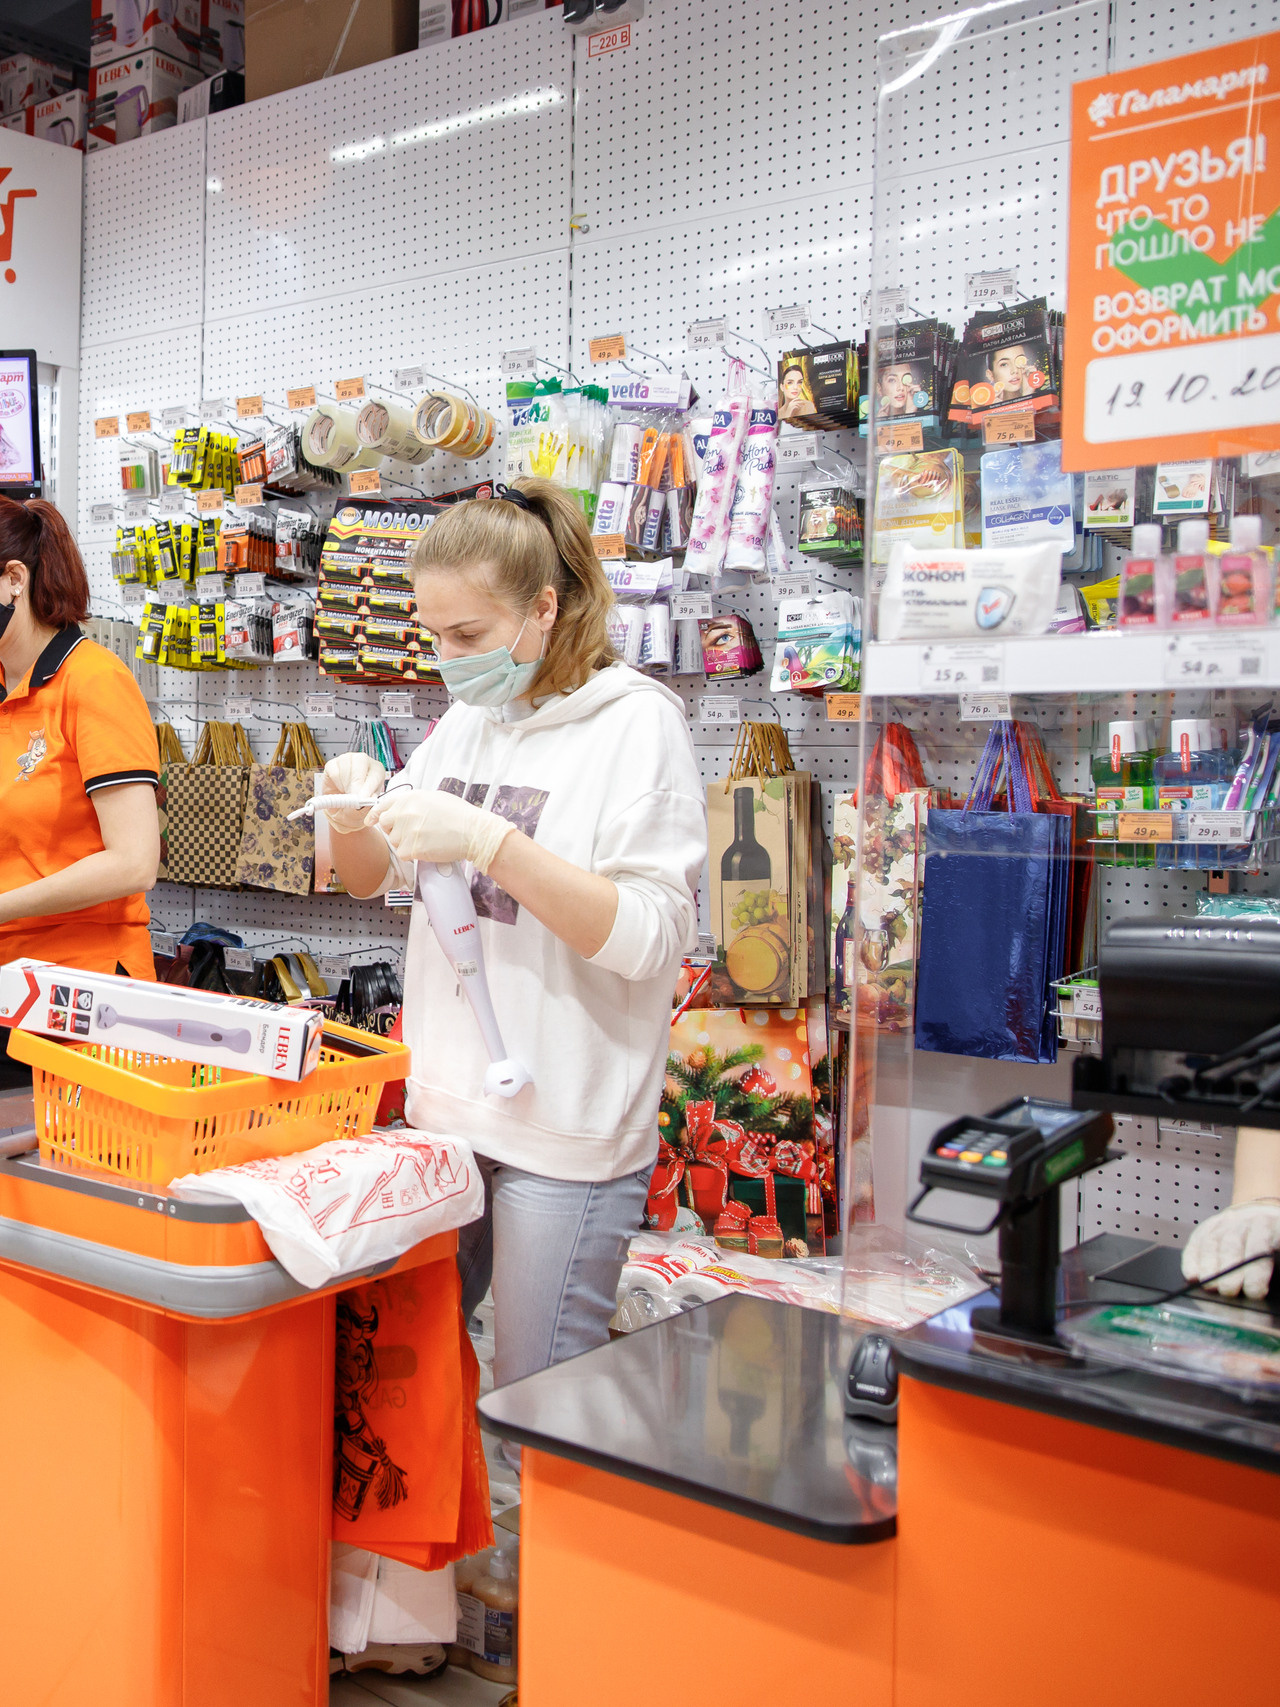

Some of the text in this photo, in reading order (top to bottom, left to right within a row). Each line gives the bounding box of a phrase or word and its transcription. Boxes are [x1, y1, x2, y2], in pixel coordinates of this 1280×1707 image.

[98, 64, 131, 85] LEBEN
[155, 57, 183, 79] LEBEN
[1118, 63, 1269, 117] Галамарт
[36, 101, 62, 119] LEBEN
[1095, 133, 1267, 210] ДРУЗЬЯ!
[1095, 213, 1267, 270] ПОШЛО НЕ
[973, 289, 989, 298] 119
[1093, 273, 1228, 323] ВОЗВРАТ
[775, 323, 789, 331] 139
[1003, 318, 1024, 330] LOOK
[1091, 303, 1268, 353] ОФОРМИТЬ
[895, 337, 914, 347] LOOK
[983, 333, 1026, 348] ПАТЧИ ДЛЯ ГЛАЗ
[598, 351, 606, 359] 49
[1032, 373, 1040, 384] 5
[612, 382, 649, 399] vetta
[917, 394, 924, 404] 5
[997, 432, 1008, 440] 75
[745, 458, 774, 476] Pads
[1087, 474, 1120, 483] ELASTIC
[363, 509, 436, 532] МОНОЛ
[595, 500, 615, 534] vetta
[990, 512, 1030, 526] COLLAGEN
[642, 508, 660, 546] vetta
[692, 541, 707, 550] 120
[750, 536, 764, 547] 120
[778, 587, 788, 595] 39
[226, 605, 255, 621] Energizer
[275, 607, 305, 623] Energizer
[1181, 661, 1202, 674] 54
[933, 669, 951, 682] 15
[970, 705, 982, 714] 76
[1133, 827, 1147, 836] 49
[1197, 828, 1210, 837] 29
[453, 923, 475, 935] LEBEN
[1082, 1003, 1094, 1012] 54
[258, 1023, 270, 1054] Блендер
[275, 1026, 292, 1072] LEBEN
